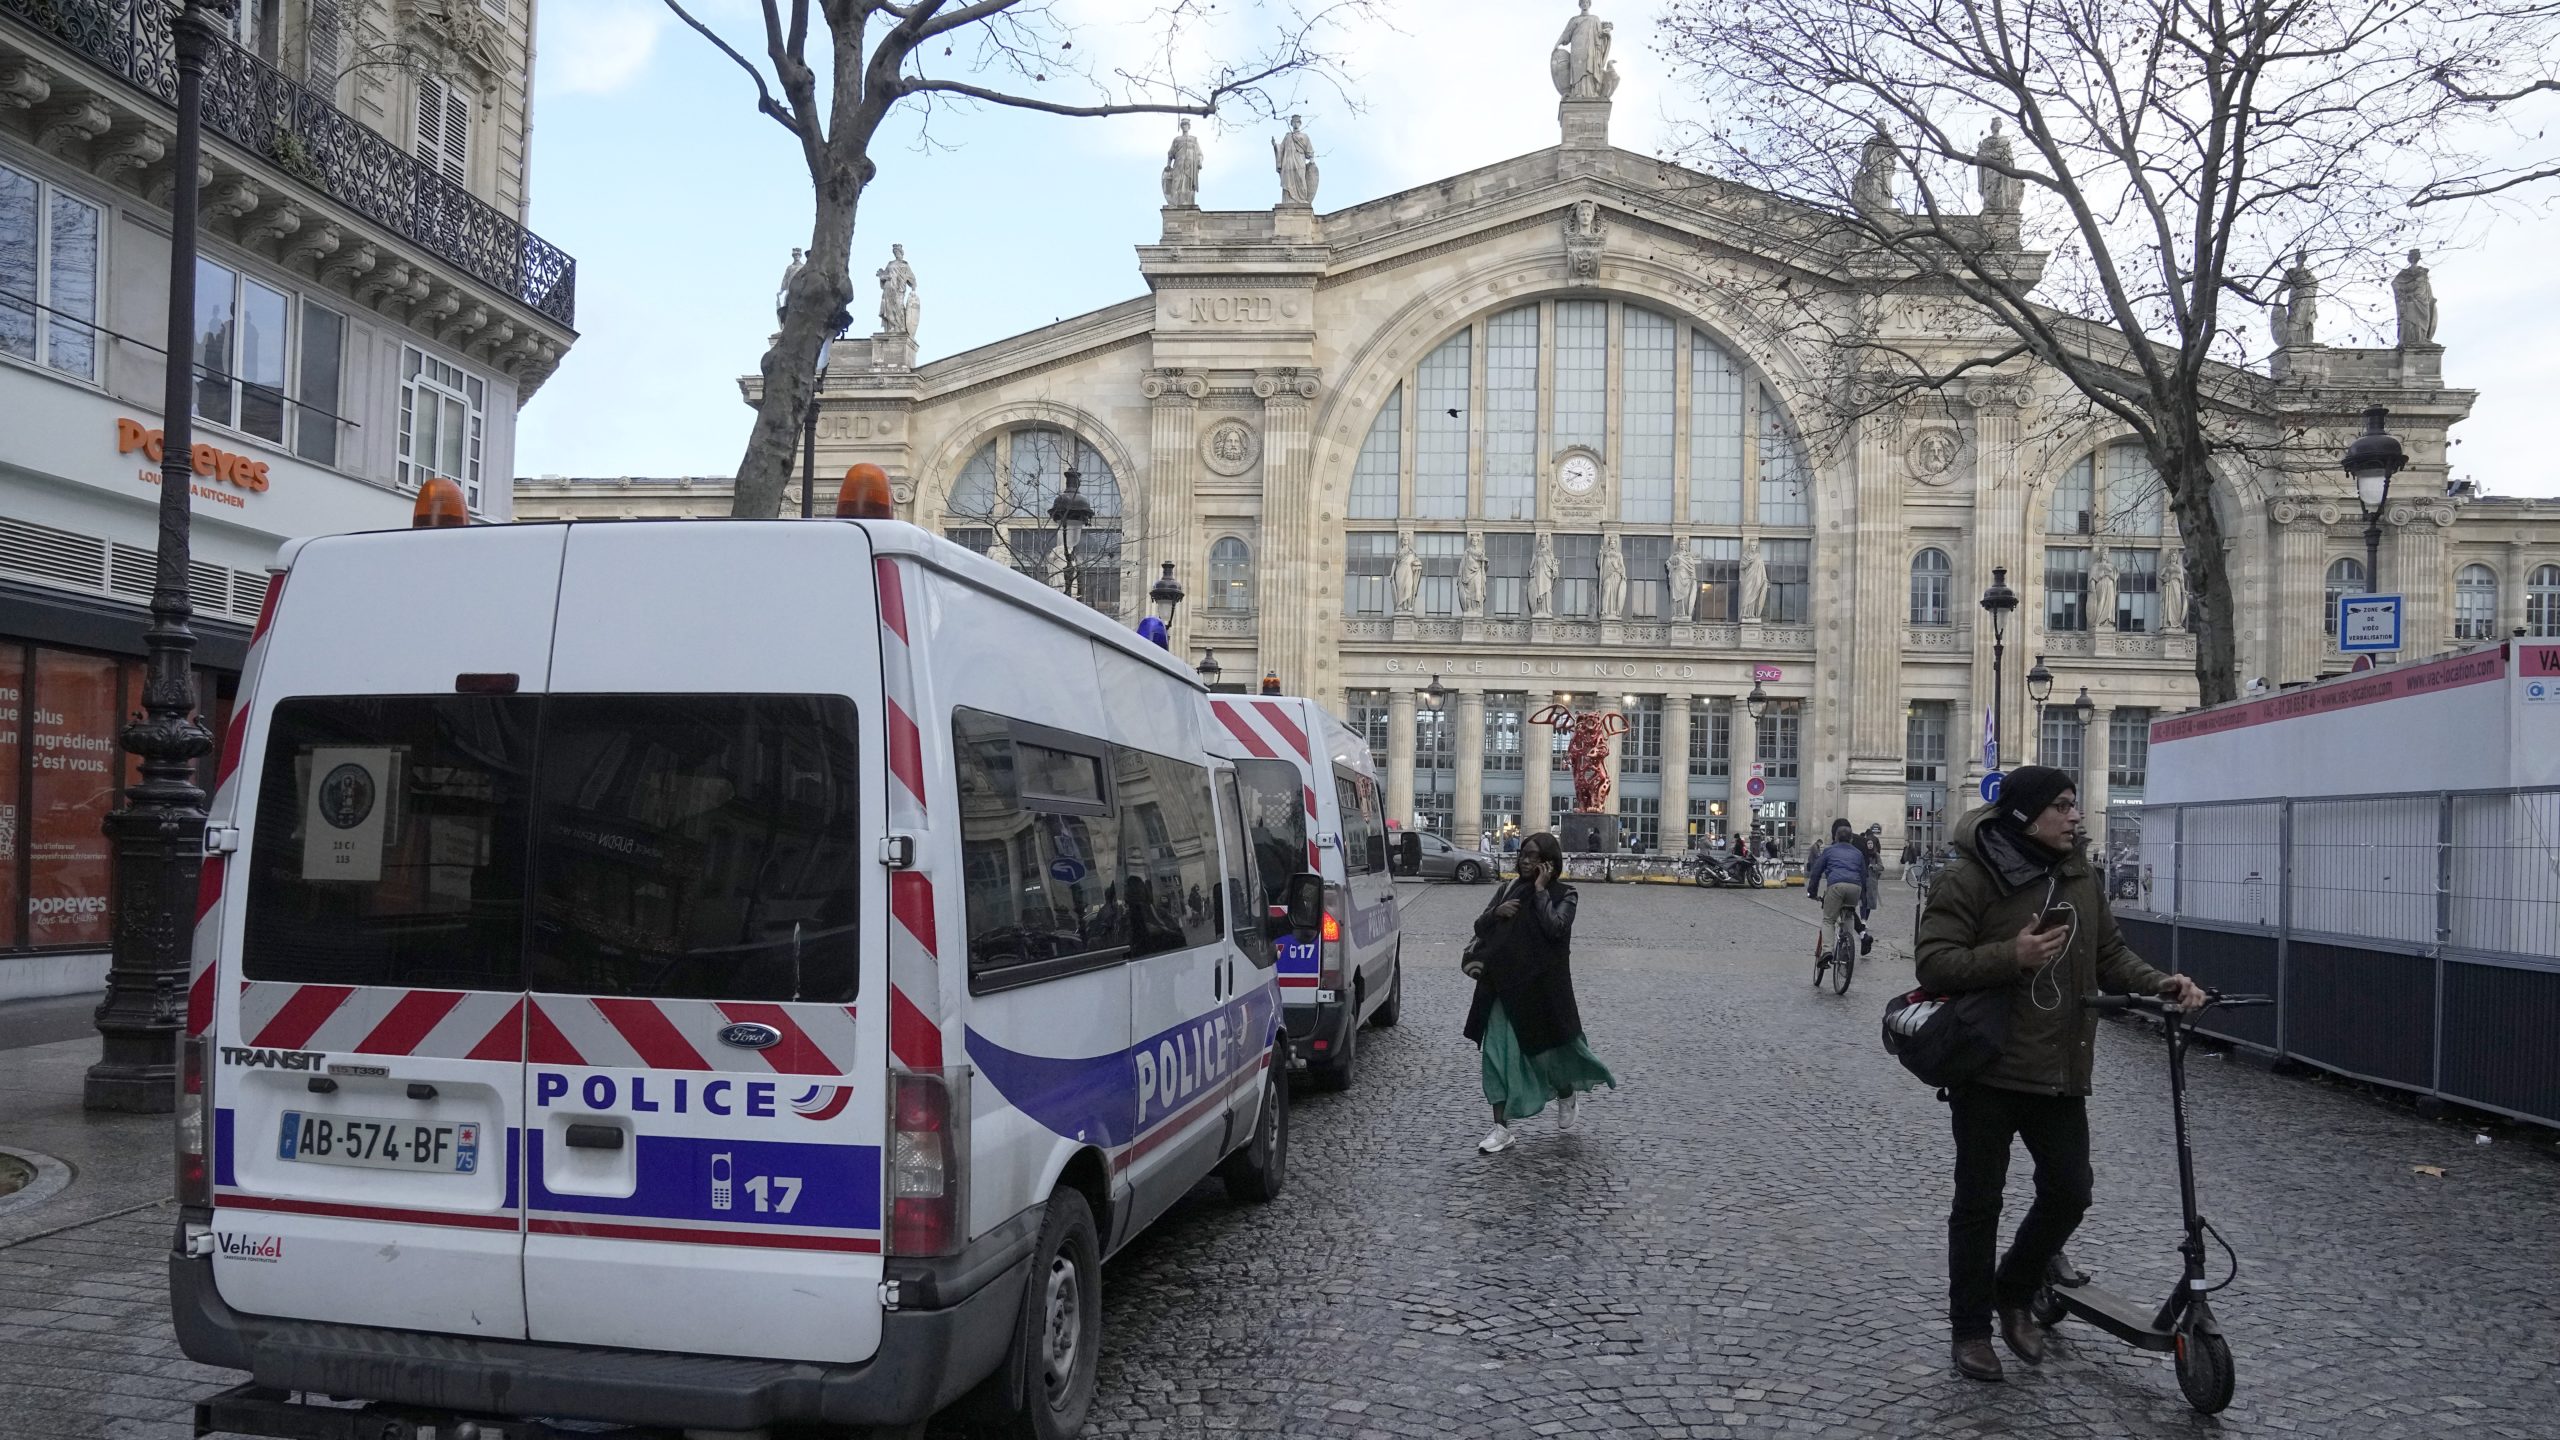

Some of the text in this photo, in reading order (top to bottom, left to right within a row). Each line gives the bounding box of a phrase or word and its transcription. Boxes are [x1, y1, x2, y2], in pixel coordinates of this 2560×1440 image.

[1189, 296, 1274, 323] NORD
[815, 415, 873, 440] ORD
[200, 486, 245, 509] KITCHEN
[1386, 658, 1694, 679] GARE DU NORD
[1755, 669, 1781, 679] SNCF
[2406, 658, 2495, 691] www.vac-location.com
[2321, 680, 2393, 706] www.vac-location.com
[69, 757, 108, 773] vous.
[335, 855, 351, 864] 113
[1297, 944, 1315, 959] 17
[220, 1046, 326, 1072] TRANSIT
[1135, 1013, 1229, 1126] POLICE
[536, 1072, 776, 1118] POLICE
[299, 1118, 453, 1164] AB-574-BF
[457, 1151, 474, 1169] 75
[744, 1175, 803, 1214] 17
[217, 1231, 282, 1258] Vehixel
